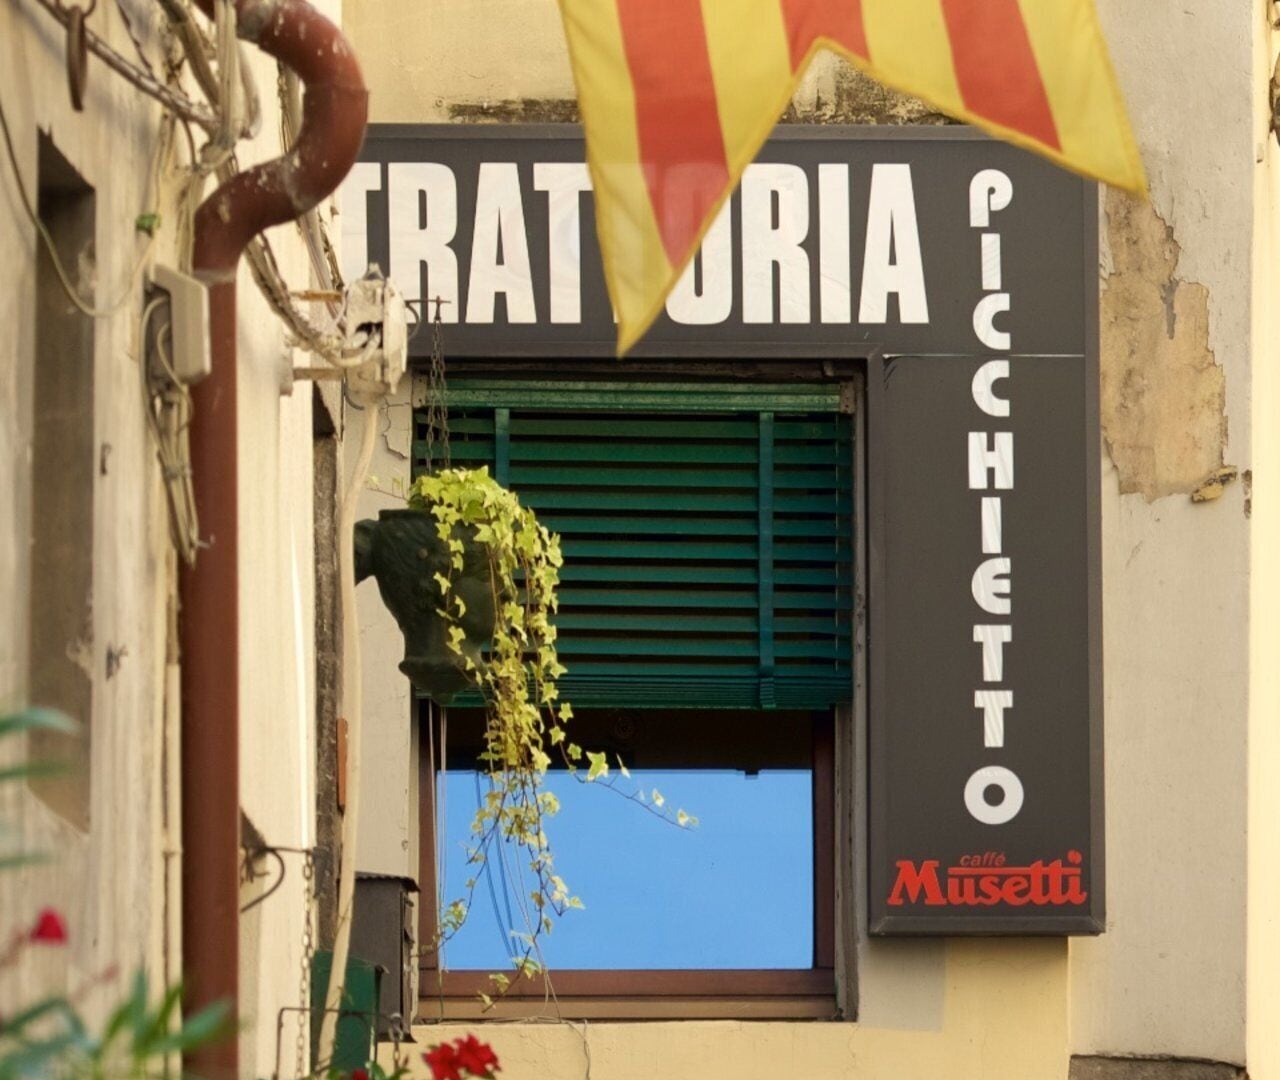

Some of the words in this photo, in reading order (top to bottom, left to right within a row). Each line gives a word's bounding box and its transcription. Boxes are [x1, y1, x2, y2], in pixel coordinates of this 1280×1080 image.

[341, 162, 930, 324] TRATORIA
[963, 169, 1024, 825] PICCHIETTO
[887, 849, 1087, 906] Musetti
